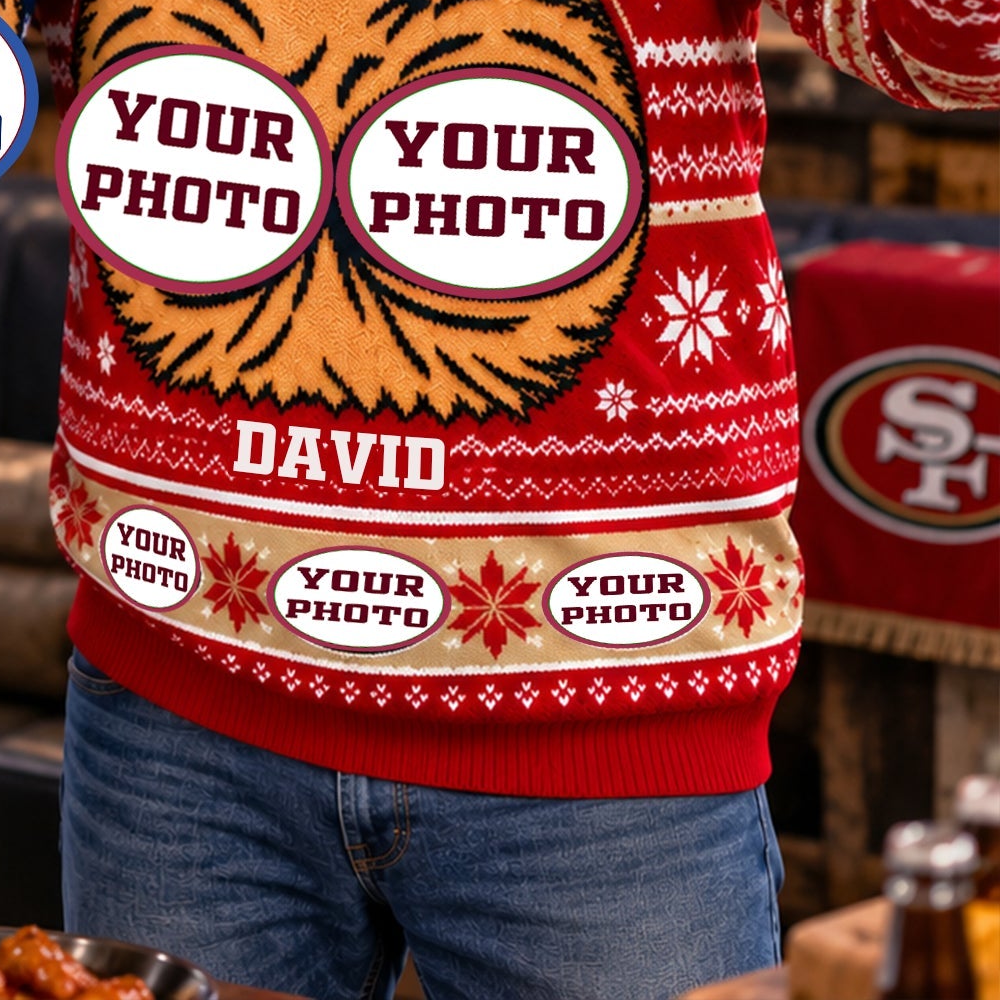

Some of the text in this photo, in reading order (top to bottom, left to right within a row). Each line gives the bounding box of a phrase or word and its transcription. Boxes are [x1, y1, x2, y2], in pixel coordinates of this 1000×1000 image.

[107, 88, 294, 163] YOUR
[384, 119, 596, 175] YOUR
[80, 163, 301, 235] PHOTO
[368, 190, 606, 242] PHOTO
[232, 419, 446, 491] DAVID
[116, 522, 186, 562] YOUR
[110, 553, 189, 593] PHOTO
[296, 566, 424, 598] YOUR
[567, 573, 685, 597] YOUR
[285, 598, 429, 629] PHOTO
[561, 602, 692, 625] PHOTO
